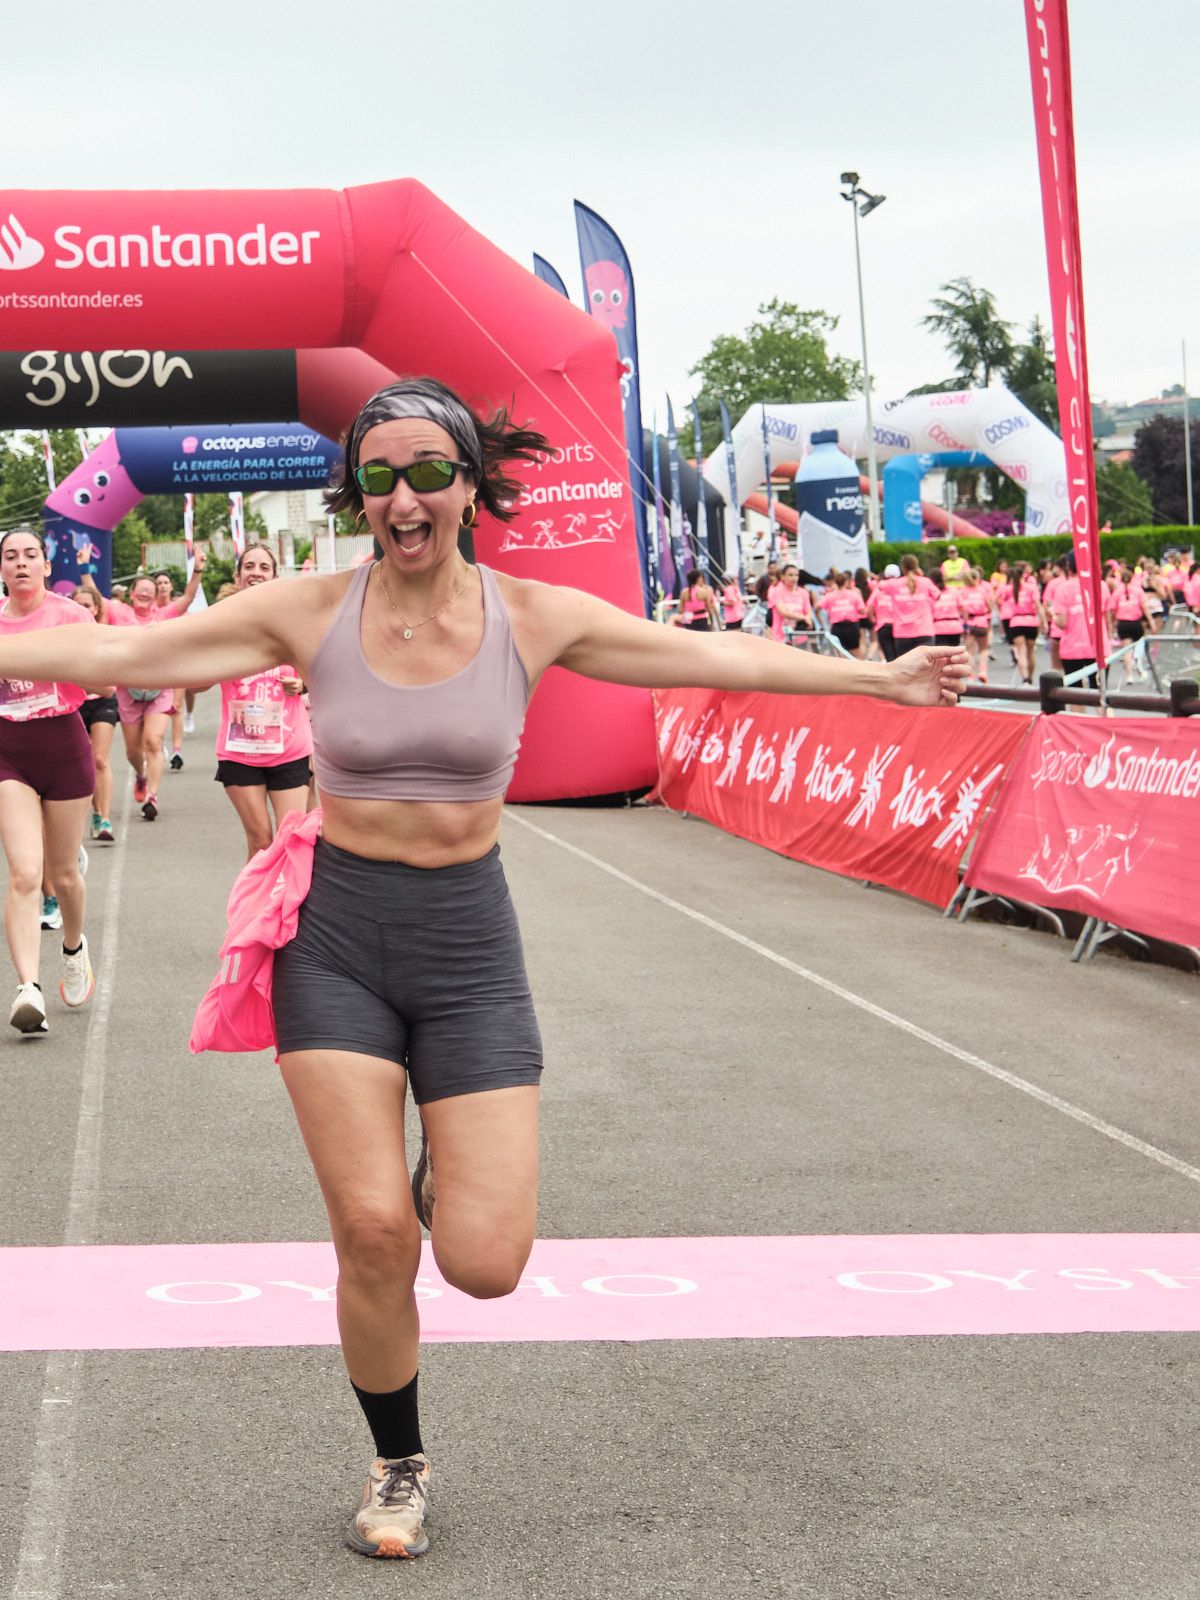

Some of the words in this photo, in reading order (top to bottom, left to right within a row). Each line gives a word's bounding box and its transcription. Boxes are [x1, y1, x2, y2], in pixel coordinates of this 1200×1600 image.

[55, 223, 320, 269] Santander
[984, 415, 1030, 444] COSMO
[173, 461, 188, 471] LA
[191, 457, 240, 471] ENERGÍA
[243, 458, 275, 469] PARA
[277, 456, 326, 468] CORRER
[173, 474, 182, 483] A
[184, 473, 200, 483] LA
[201, 470, 268, 482] VELOCIDAD
[270, 470, 286, 480] DE
[288, 469, 305, 480] LA
[307, 468, 329, 479] LUZ
[519, 478, 624, 506] Santander
